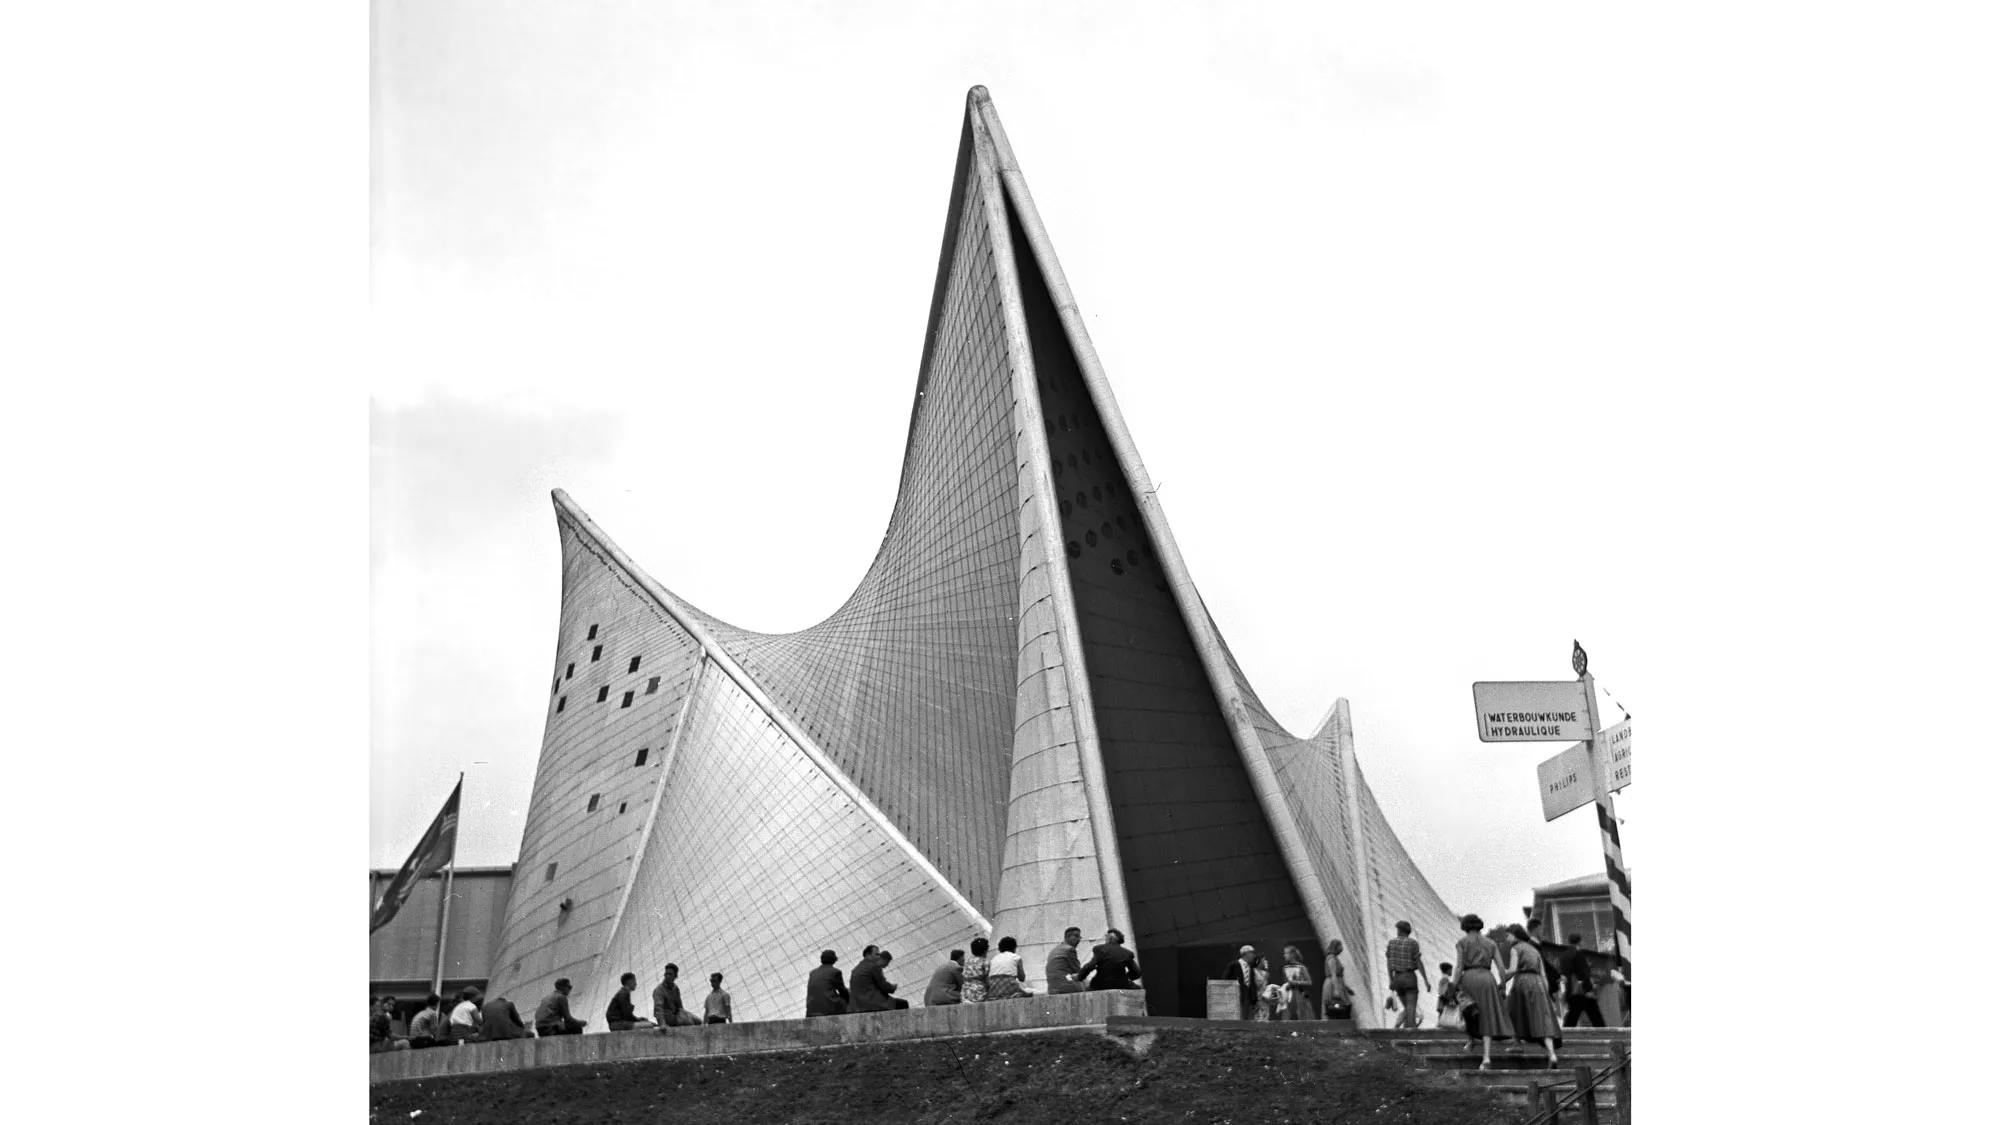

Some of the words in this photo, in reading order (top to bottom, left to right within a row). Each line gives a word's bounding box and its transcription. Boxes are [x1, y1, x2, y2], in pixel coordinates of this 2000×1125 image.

[1488, 712, 1577, 723] WATERBOUWKUNDE
[1491, 725, 1561, 737] HYDRAULIQUE
[1549, 773, 1577, 794] PHILIPS
